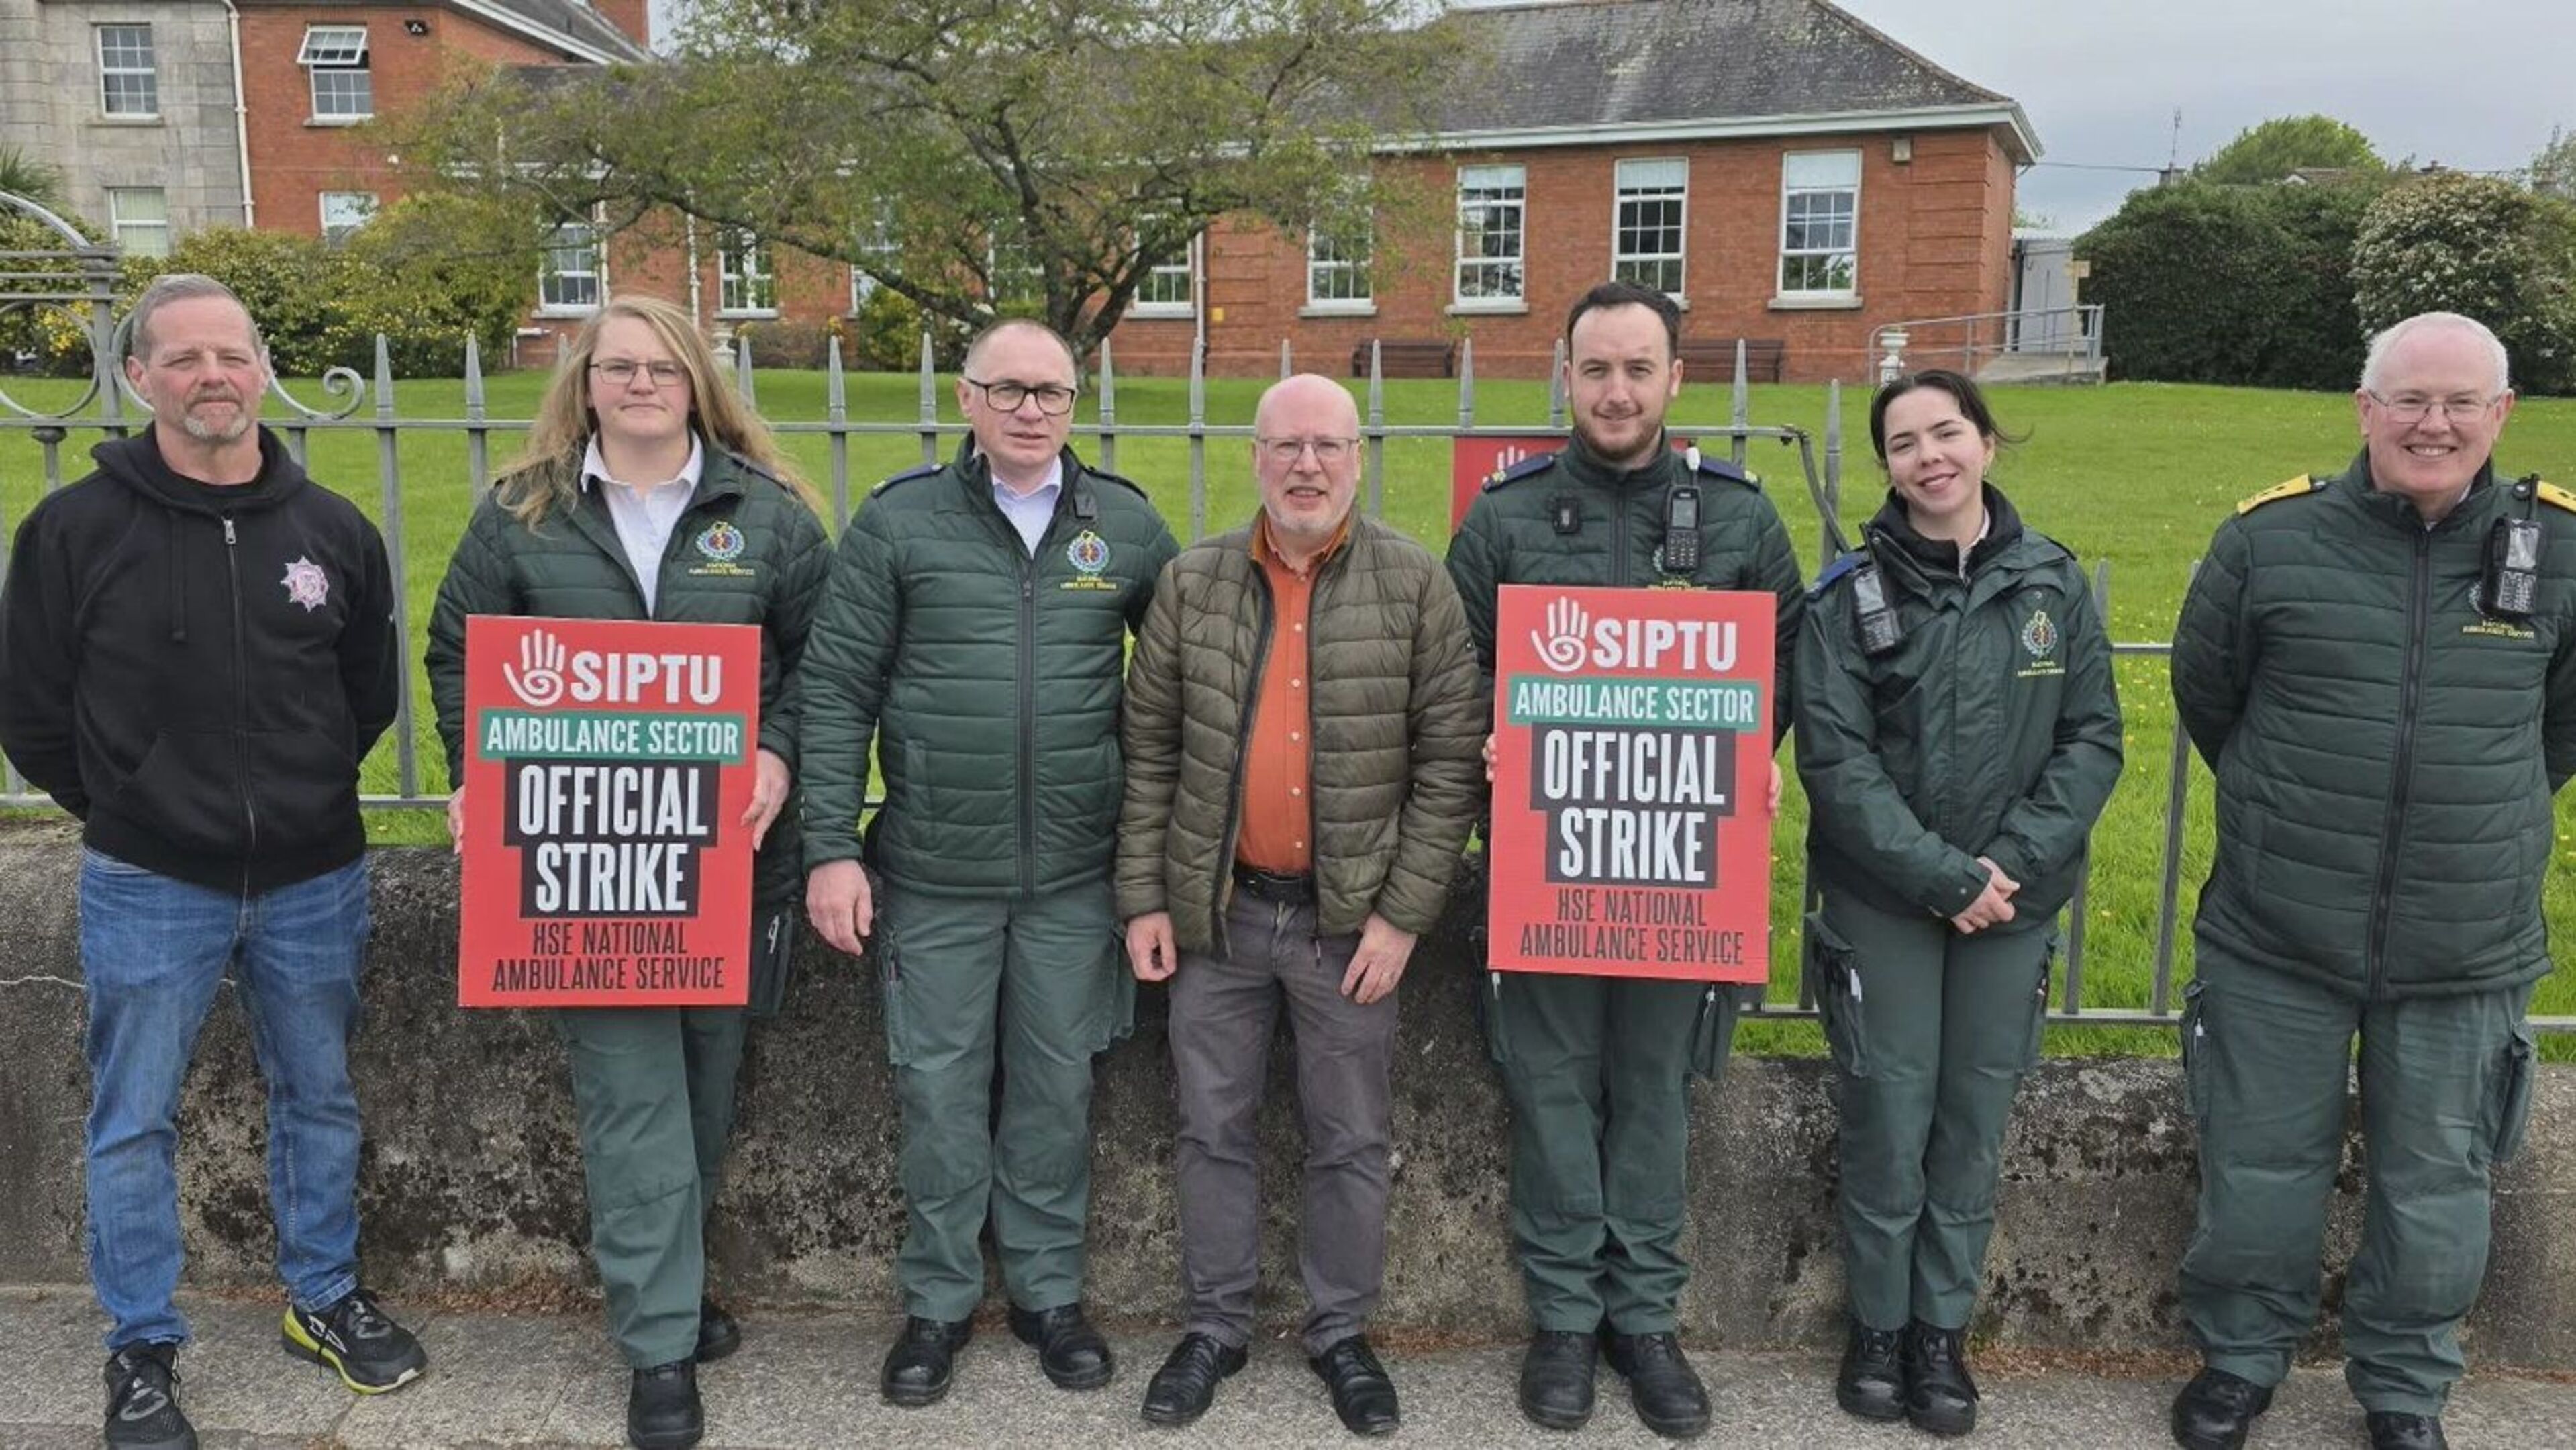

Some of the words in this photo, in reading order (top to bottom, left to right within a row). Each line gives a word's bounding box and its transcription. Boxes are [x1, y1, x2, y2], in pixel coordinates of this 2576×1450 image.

[1592, 619, 1737, 671] SIPTU
[570, 650, 722, 706] SIPTU
[1514, 681, 1658, 720] AMBULANCE
[1665, 687, 1754, 724] SECTOR
[485, 716, 640, 755] AMBULANCE
[646, 720, 738, 755] SECTOR
[1544, 728, 1726, 806] OFFICIAL
[517, 764, 709, 836] OFFICIAL
[1559, 807, 1707, 883] STRIKE
[536, 842, 688, 912] STRIKE
[1556, 888, 1596, 923] HSE
[1605, 890, 1707, 928] NATIONAL
[532, 922, 575, 956] HSE
[581, 921, 687, 956] NATIONAL
[1520, 924, 1648, 961] AMBULANCE
[1656, 928, 1744, 965] SERVICE
[491, 958, 628, 992] AMBULANCE
[636, 957, 724, 990] SERVICE
